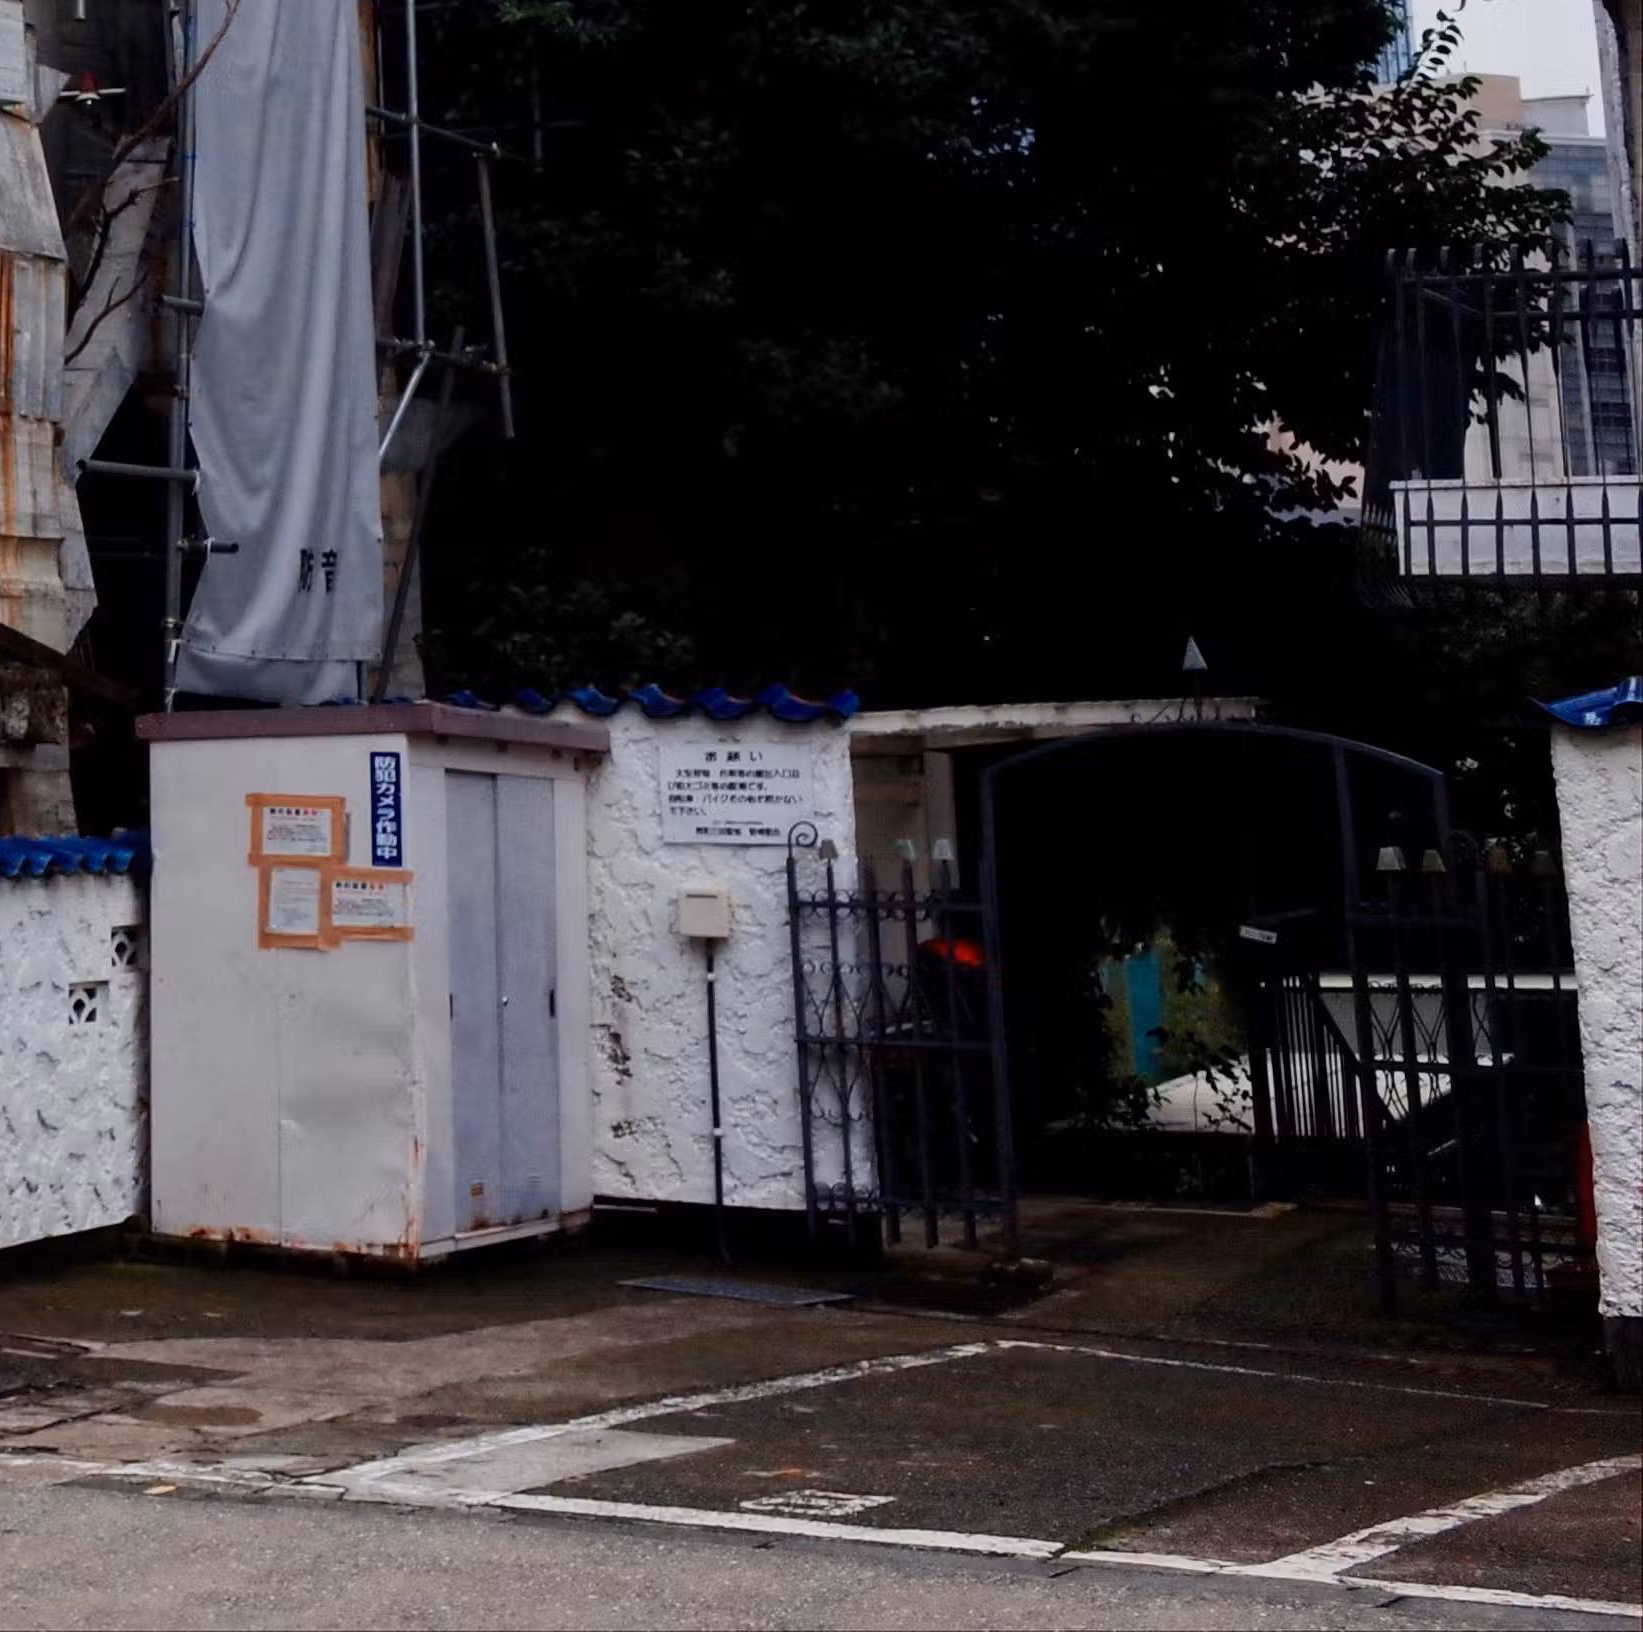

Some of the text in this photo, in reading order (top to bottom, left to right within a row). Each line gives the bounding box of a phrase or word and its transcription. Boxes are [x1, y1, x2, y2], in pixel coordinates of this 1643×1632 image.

[375, 755, 398, 860] 防犯カメラ作動中
